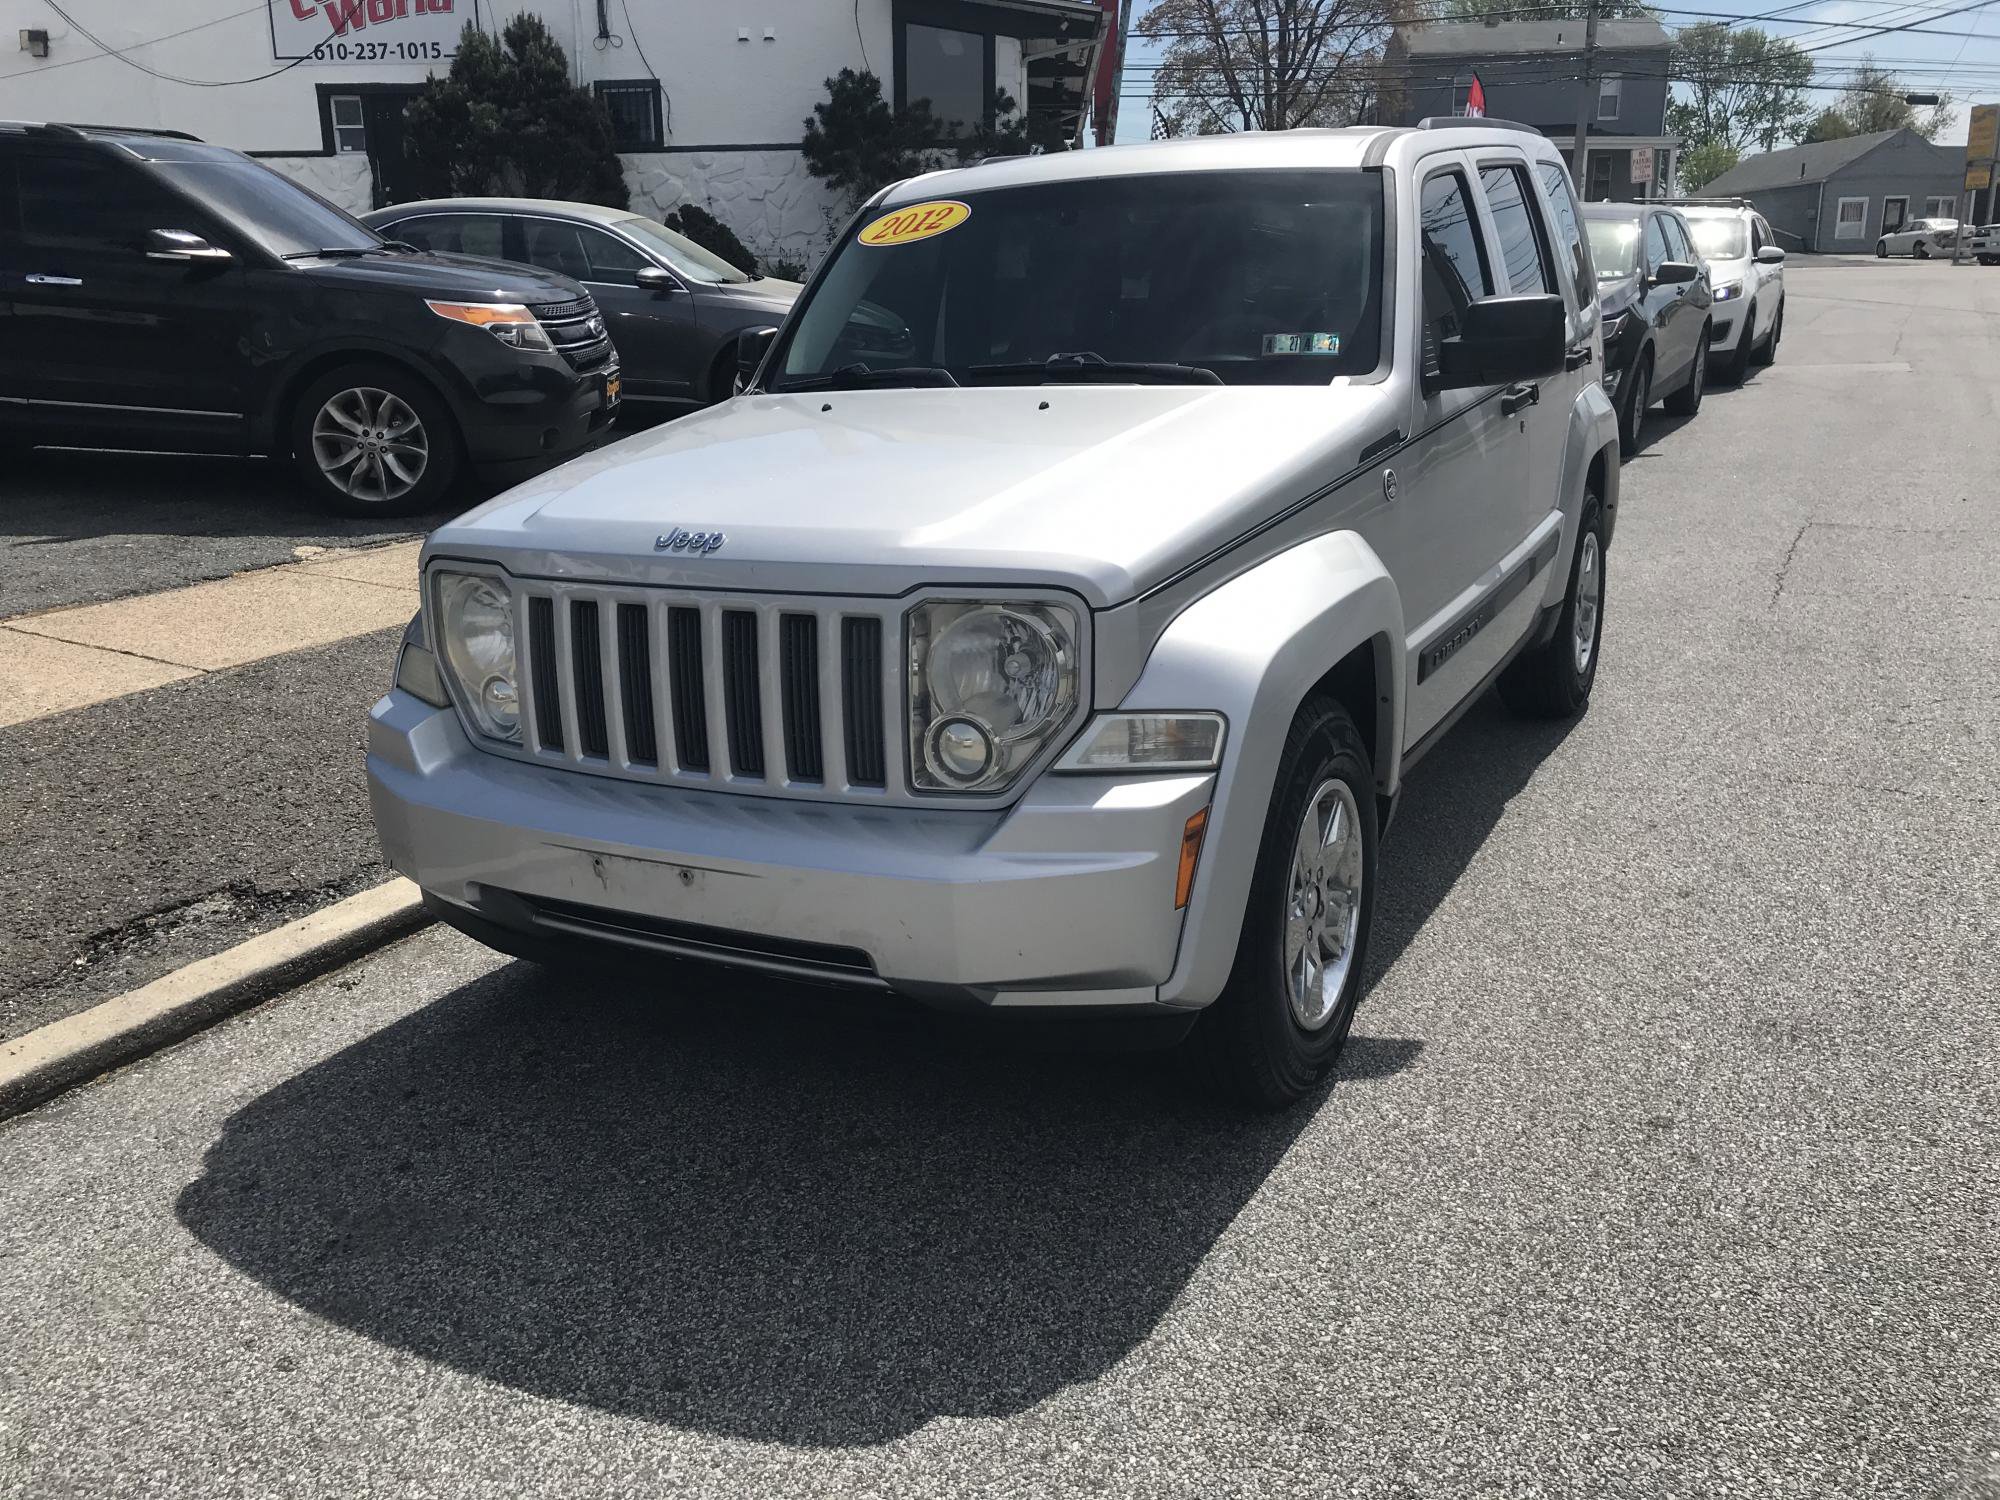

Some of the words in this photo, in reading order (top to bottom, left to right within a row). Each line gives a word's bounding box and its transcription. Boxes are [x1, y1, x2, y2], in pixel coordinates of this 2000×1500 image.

[314, 42, 441, 60] 610-237-1015
[871, 206, 954, 240] 2012
[656, 526, 726, 553] Jeep
